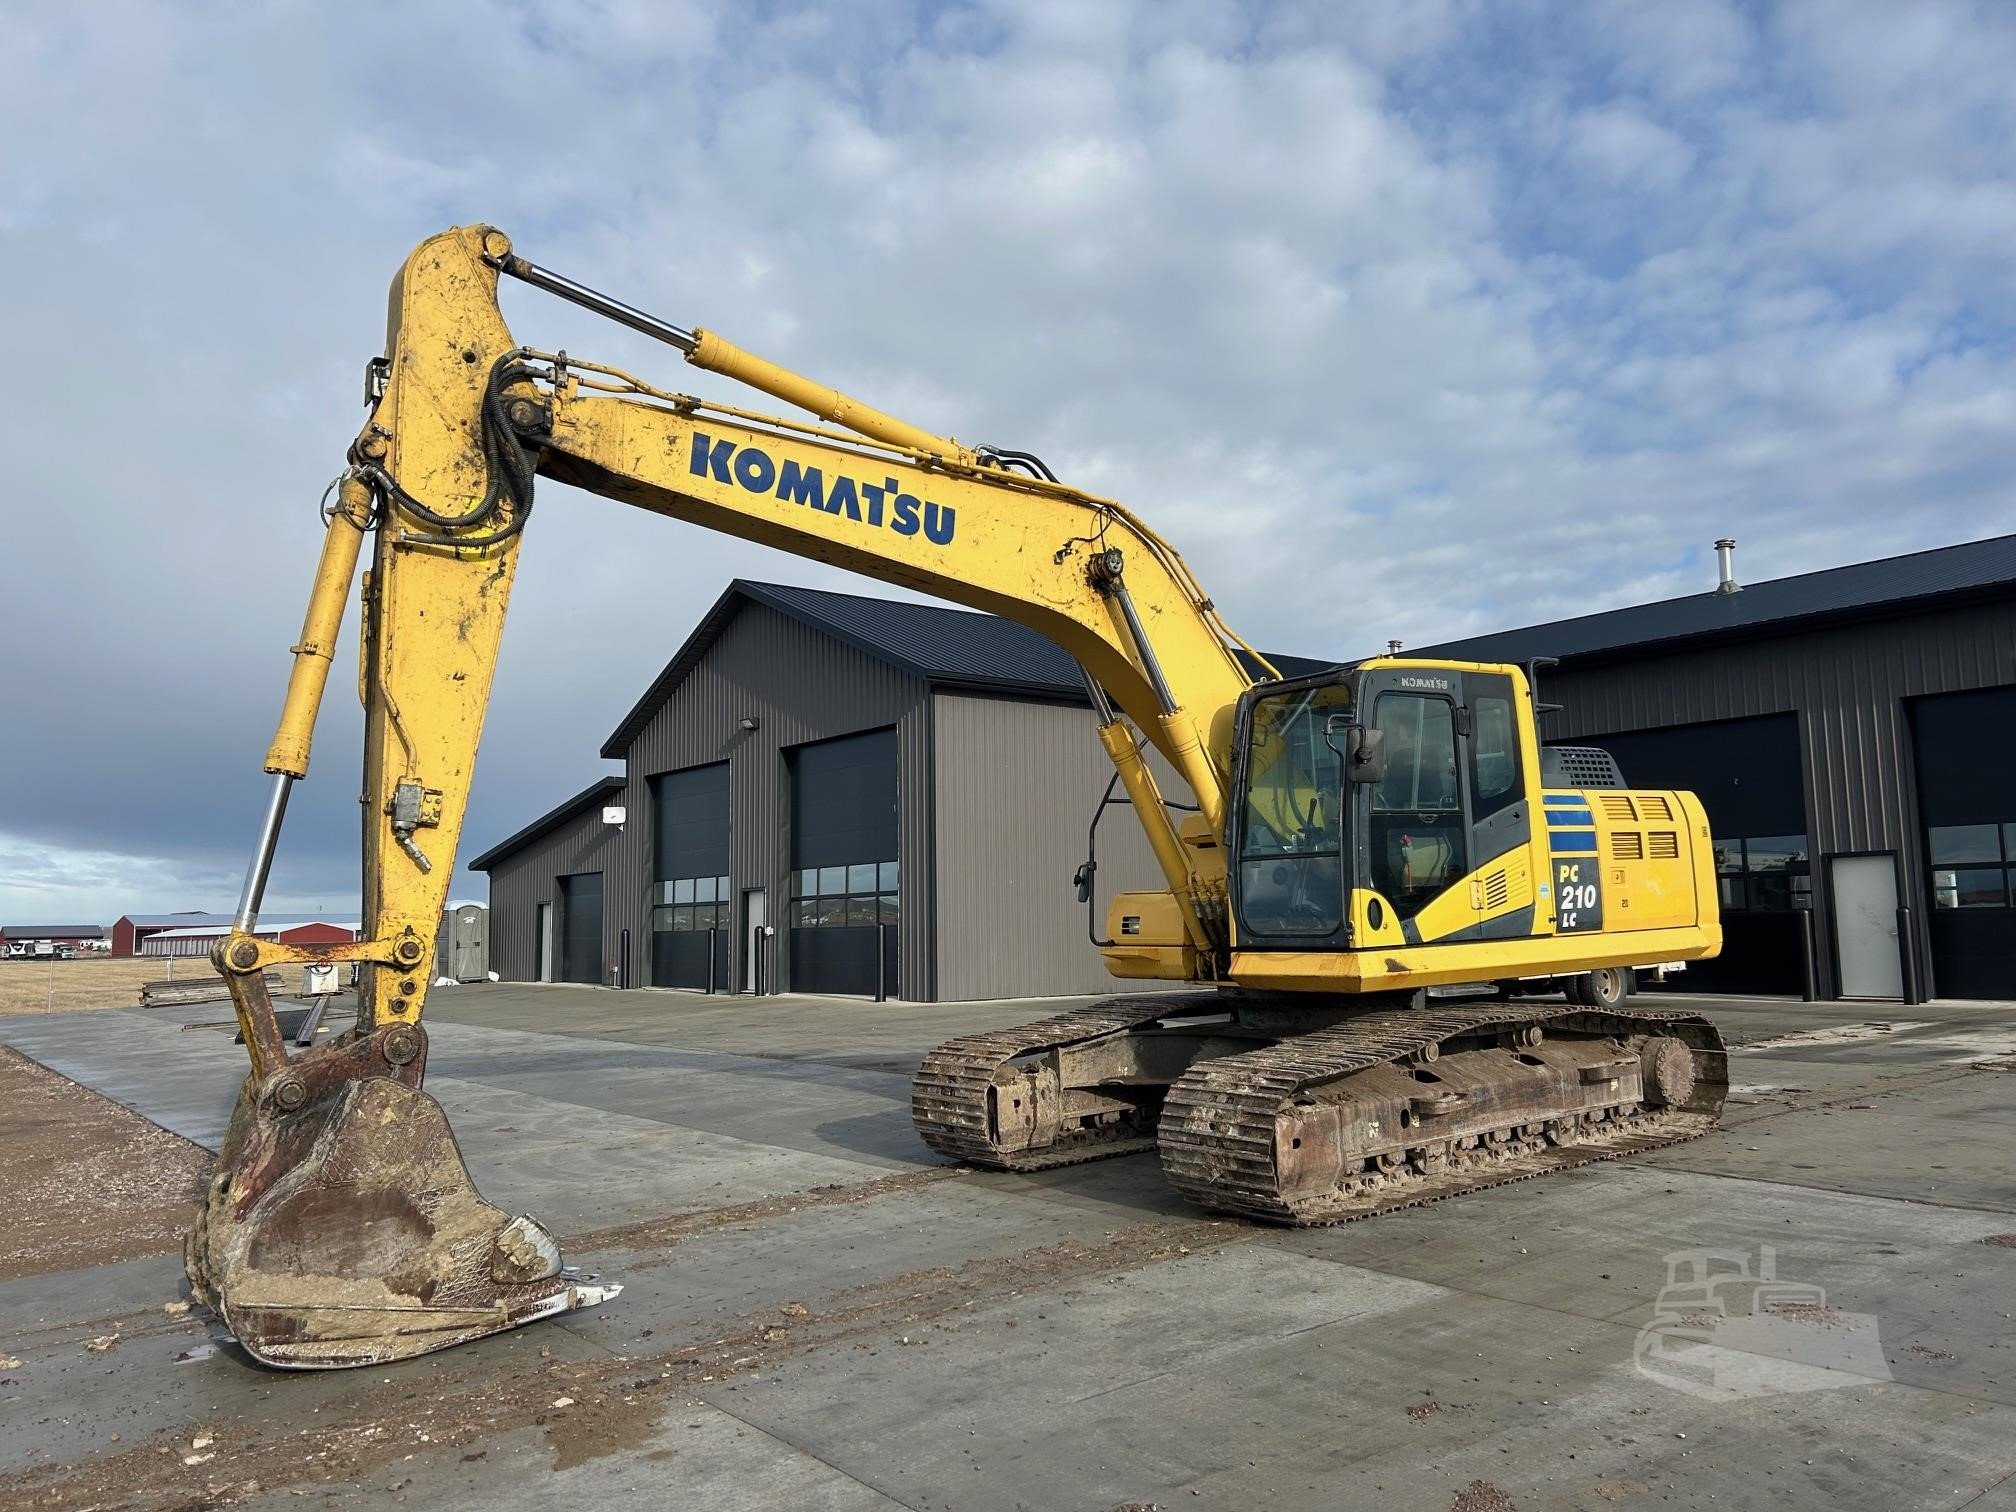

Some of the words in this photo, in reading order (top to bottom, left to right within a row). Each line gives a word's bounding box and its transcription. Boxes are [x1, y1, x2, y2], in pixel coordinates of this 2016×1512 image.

[689, 431, 956, 546] KOMATSU
[1560, 864, 1579, 883] PC
[1561, 885, 1596, 909] 210
[1562, 912, 1576, 927] LC
